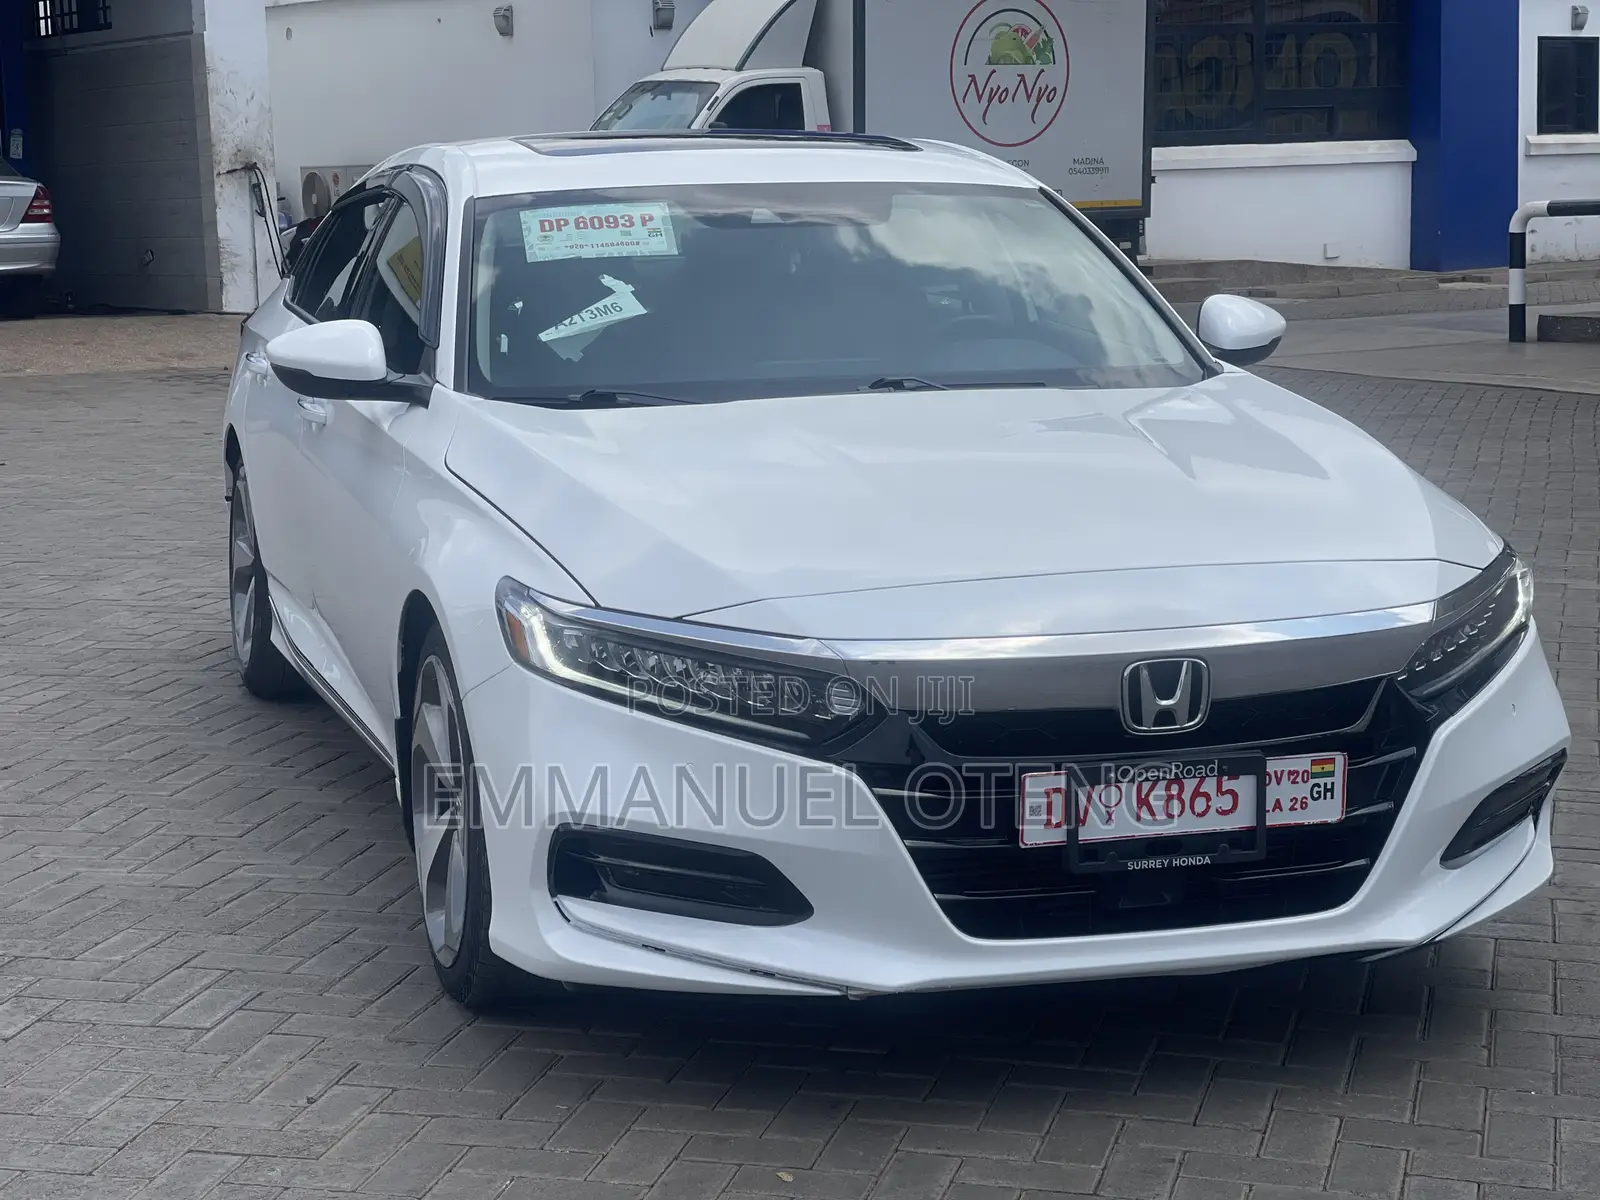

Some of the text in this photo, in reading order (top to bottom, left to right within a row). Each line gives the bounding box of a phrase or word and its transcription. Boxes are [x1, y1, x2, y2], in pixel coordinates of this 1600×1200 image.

[1072, 157, 1105, 166] MADINA
[539, 217, 570, 233] DP
[573, 213, 636, 231] 6093
[640, 213, 655, 228] P
[1116, 759, 1219, 783] OpenRoad
[1136, 775, 1240, 822] K865
[1309, 781, 1335, 802] GH
[1265, 795, 1309, 813] A 26
[1127, 856, 1212, 871] SURREY HONDA
